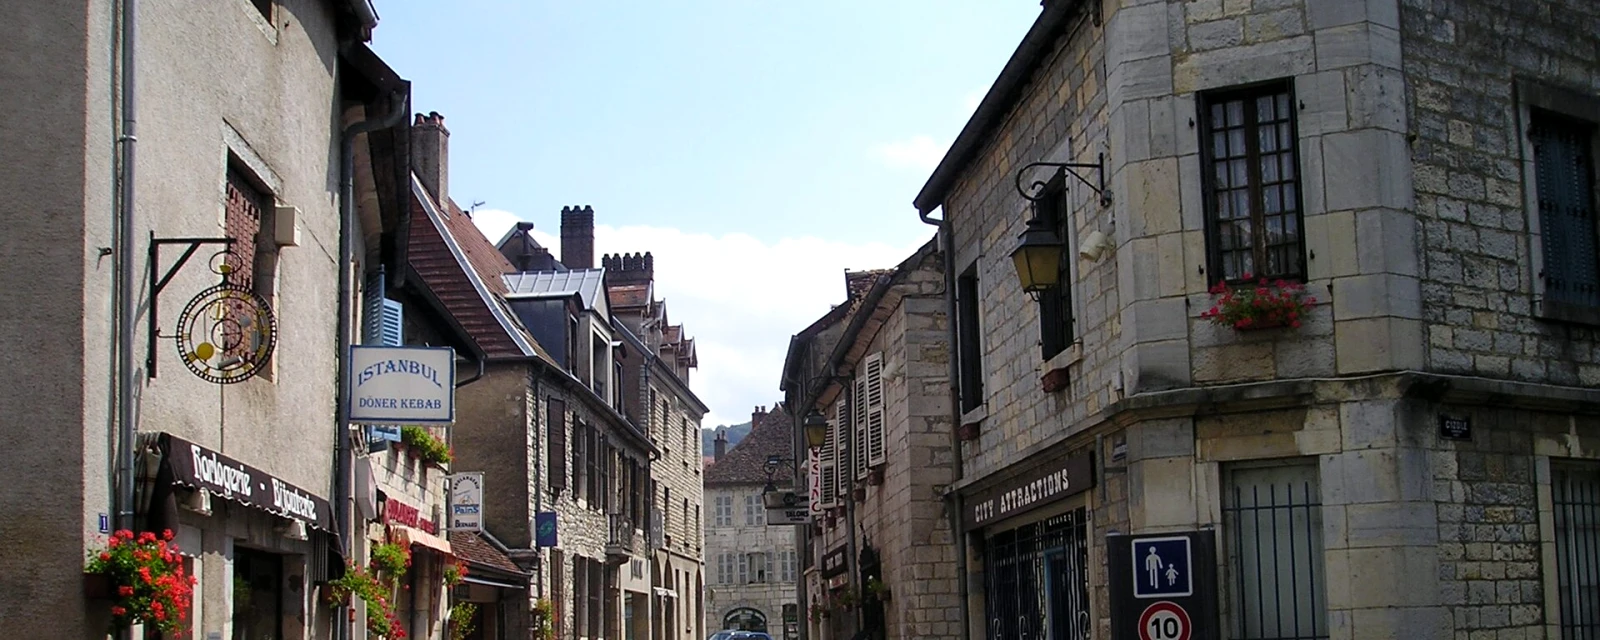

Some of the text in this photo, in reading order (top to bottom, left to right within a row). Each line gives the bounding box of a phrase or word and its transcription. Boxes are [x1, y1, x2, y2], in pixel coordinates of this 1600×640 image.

[357, 359, 442, 388] ISTANBUL
[359, 395, 442, 409] DÖNER KEBAB
[271, 477, 317, 520] Bijouterie
[974, 468, 1070, 523] CITY ATTRACTIONS
[1151, 617, 1179, 640] 10
